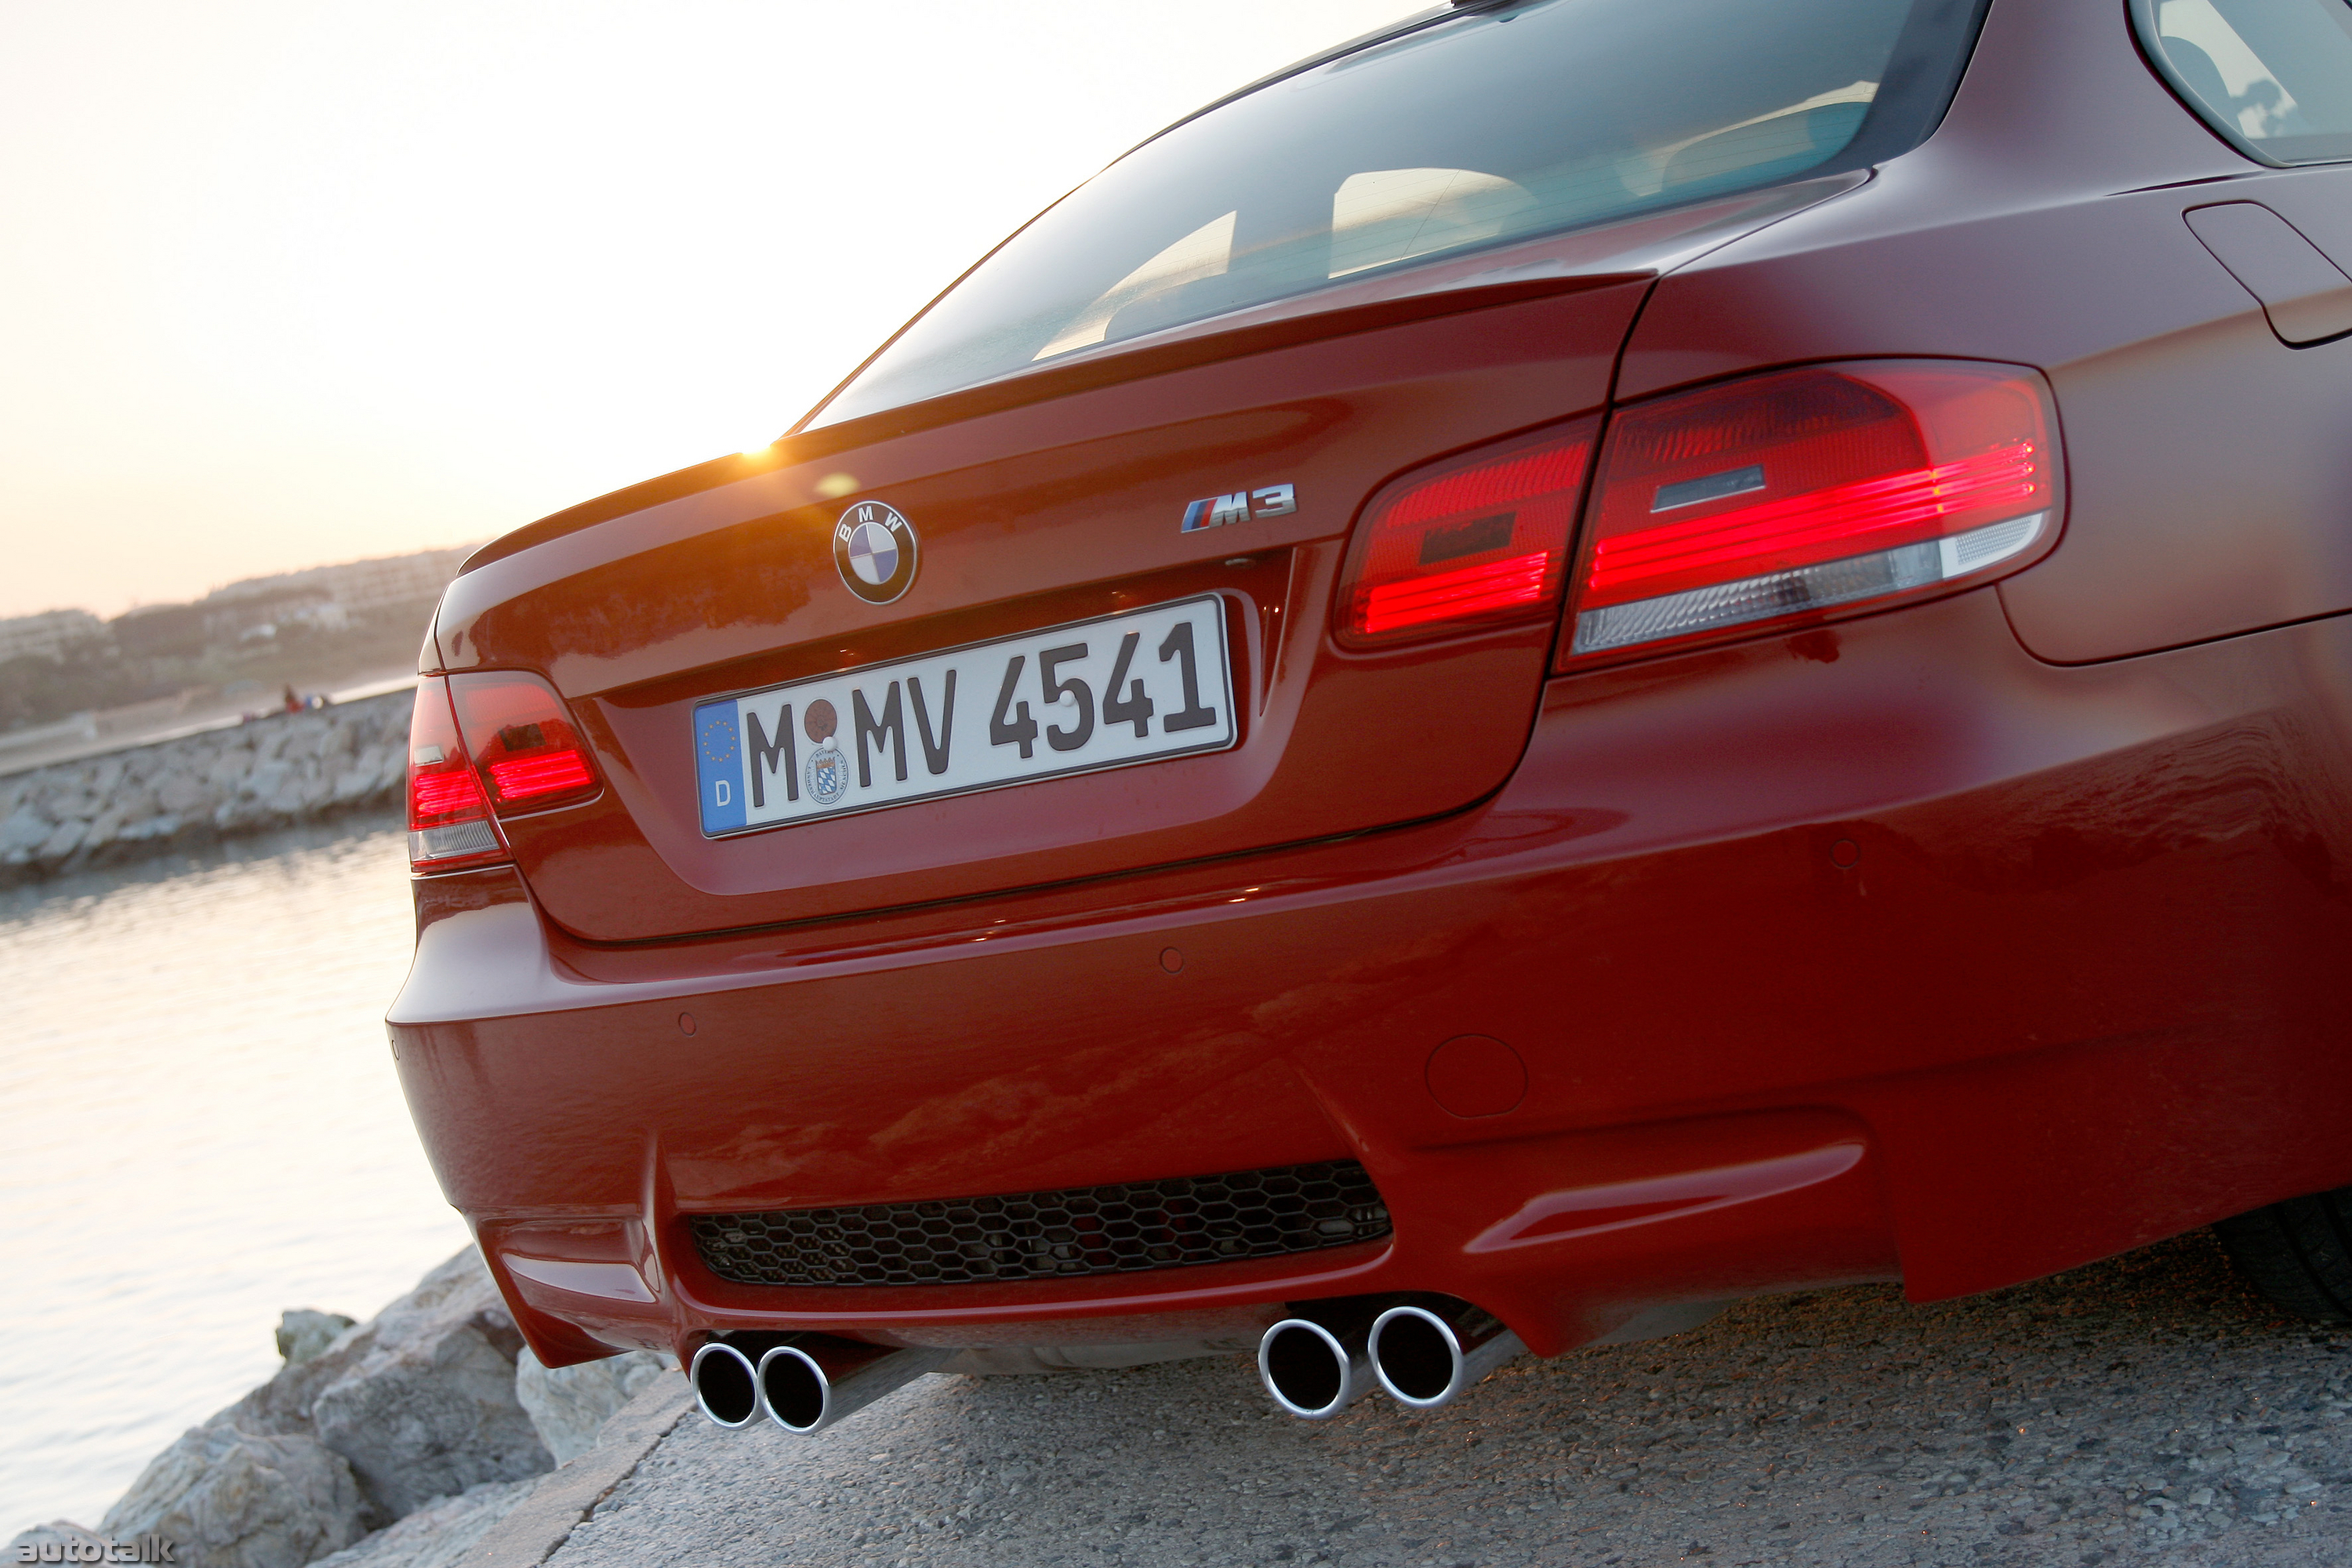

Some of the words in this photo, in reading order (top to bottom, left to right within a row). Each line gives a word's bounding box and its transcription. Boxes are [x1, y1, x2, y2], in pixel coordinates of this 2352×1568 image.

[838, 506, 902, 543] BMW
[1207, 483, 1298, 528] M3
[747, 703, 799, 808] M
[852, 670, 957, 788] MV
[989, 622, 1218, 759] 4541
[715, 779, 731, 807] D
